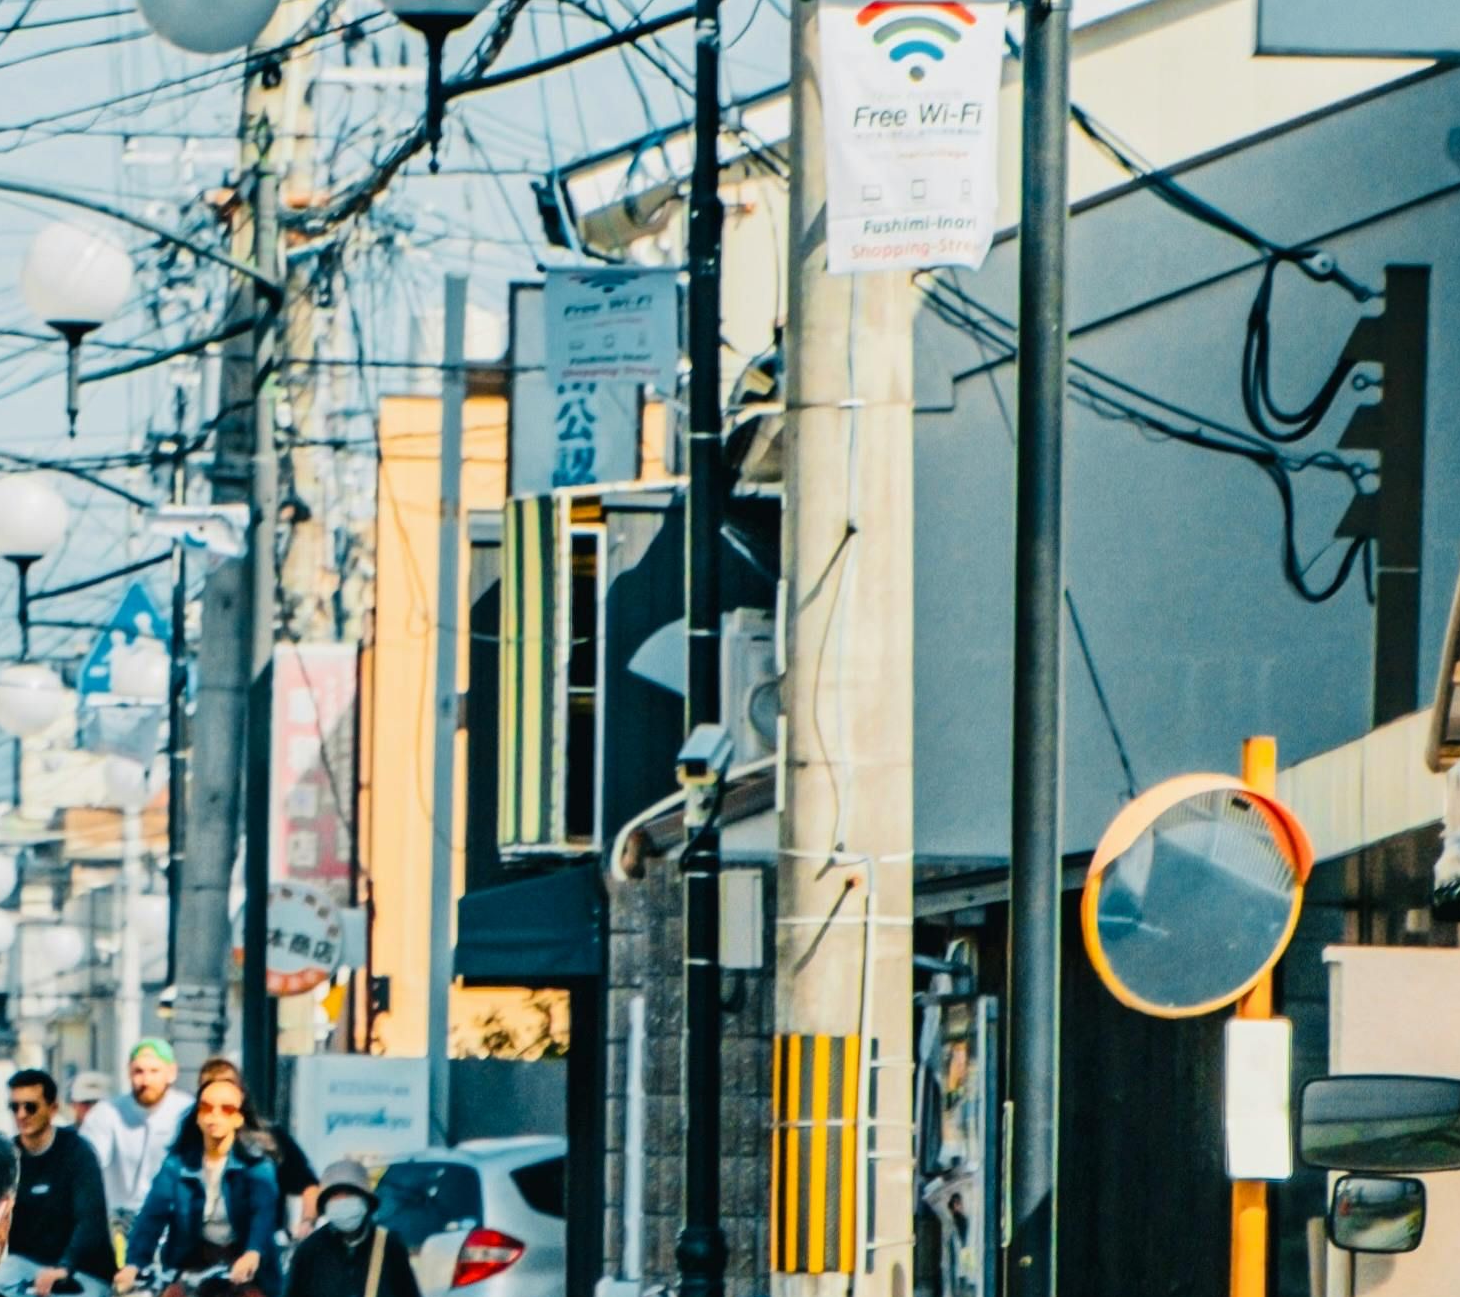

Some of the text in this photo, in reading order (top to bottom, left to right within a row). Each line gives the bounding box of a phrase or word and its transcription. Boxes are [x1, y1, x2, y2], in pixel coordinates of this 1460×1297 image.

[853, 101, 984, 129] Free Wi-Fi
[863, 215, 977, 236] Fushimi-Inari
